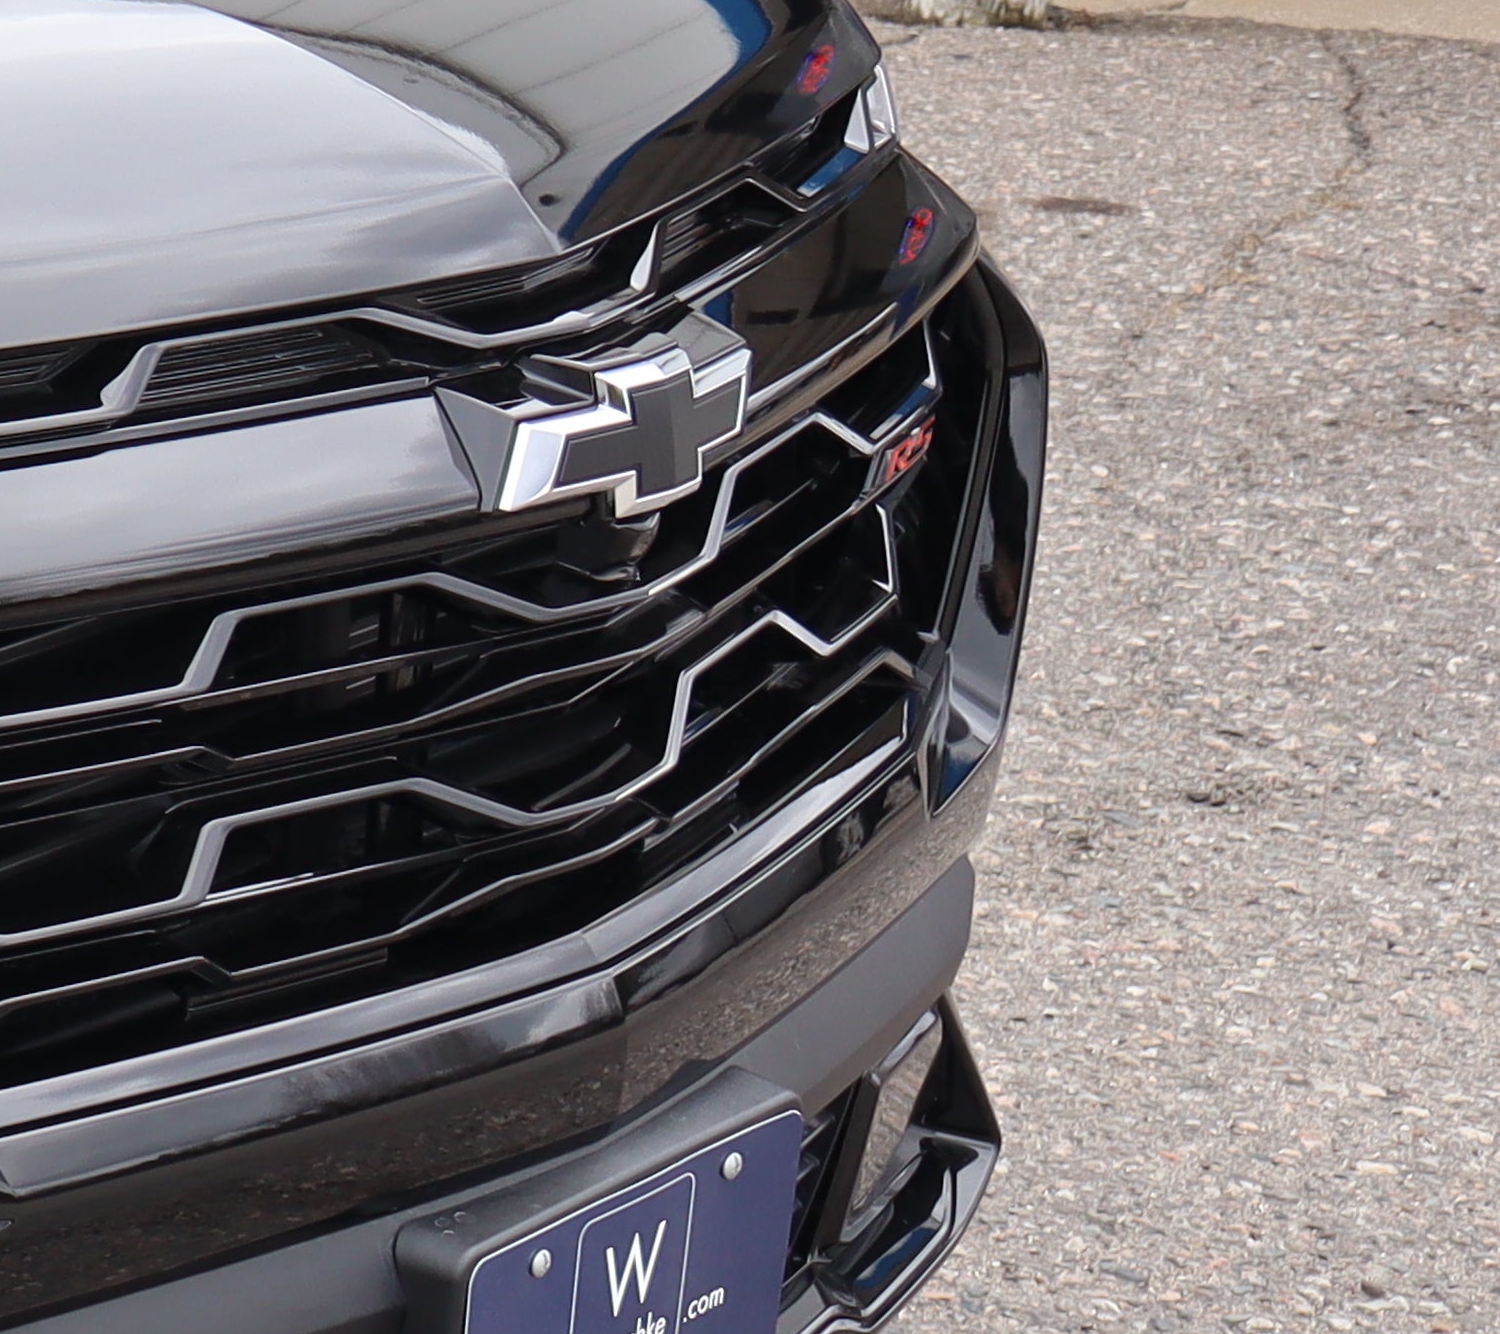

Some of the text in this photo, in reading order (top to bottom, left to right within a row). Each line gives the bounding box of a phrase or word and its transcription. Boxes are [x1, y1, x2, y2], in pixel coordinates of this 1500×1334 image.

[885, 415, 936, 484] RS
[606, 1220, 667, 1317] W
[681, 1285, 725, 1324] .com
